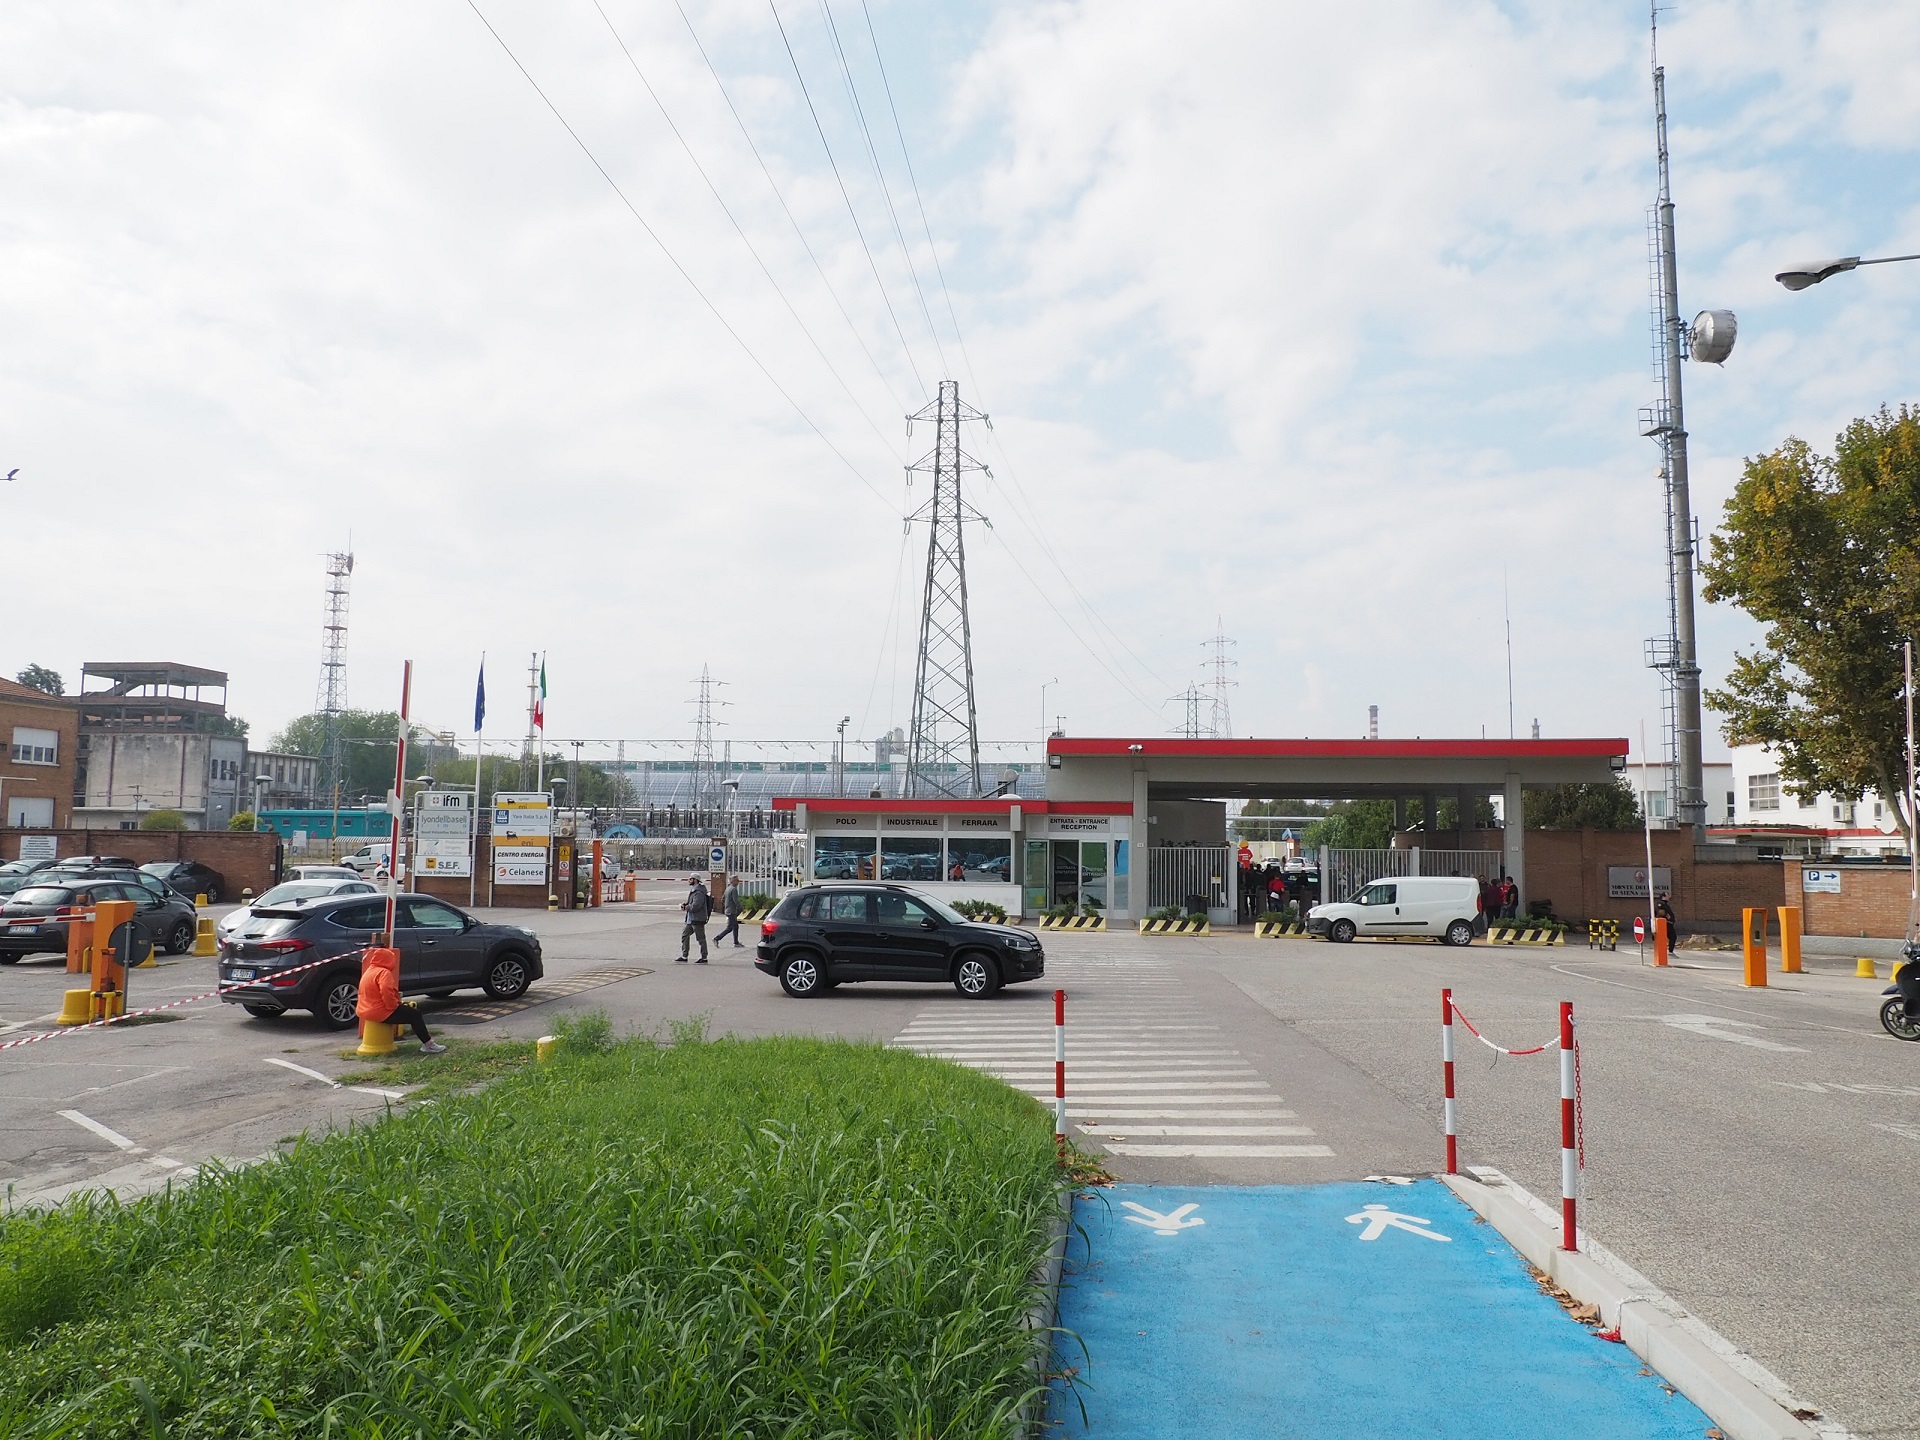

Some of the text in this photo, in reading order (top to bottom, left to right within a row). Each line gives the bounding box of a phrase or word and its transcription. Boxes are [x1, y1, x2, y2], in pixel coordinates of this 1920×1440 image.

[443, 795, 460, 807] ifm
[421, 815, 467, 824] lyondellbasell
[887, 818, 938, 826] INDUSTRIALE
[521, 838, 534, 847] eni
[508, 868, 544, 876] Celanese
